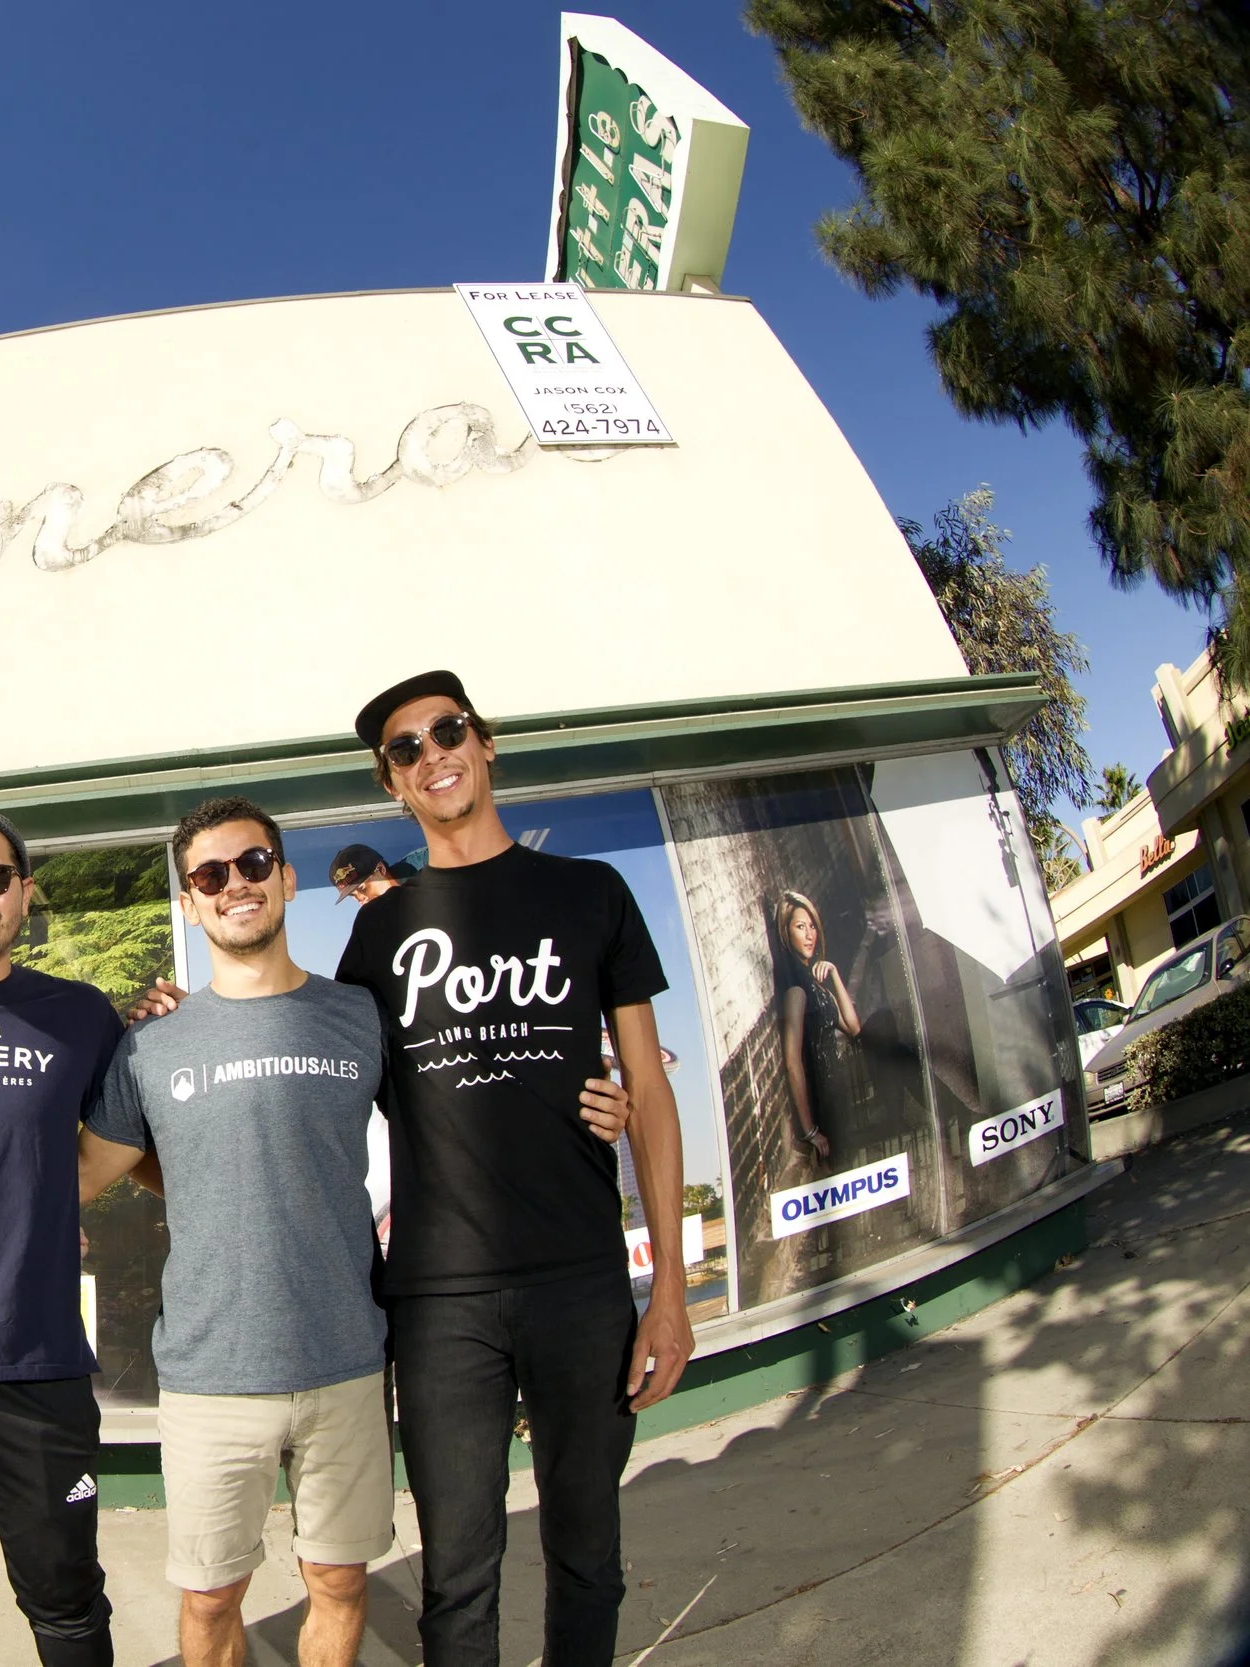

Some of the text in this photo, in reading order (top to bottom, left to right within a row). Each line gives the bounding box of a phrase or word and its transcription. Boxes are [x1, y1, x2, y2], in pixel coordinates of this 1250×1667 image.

[468, 290, 579, 301] FOR LEASE
[534, 386, 628, 396] JASON COX
[563, 402, 618, 415] (562)
[541, 418, 660, 436] 424-7974
[392, 927, 572, 1028] Port
[438, 1021, 529, 1046] LONG BEACH
[213, 1055, 359, 1084] AMBITIOUSALES
[982, 1100, 1054, 1152] SONY
[781, 1167, 899, 1222] OLYMPUS
